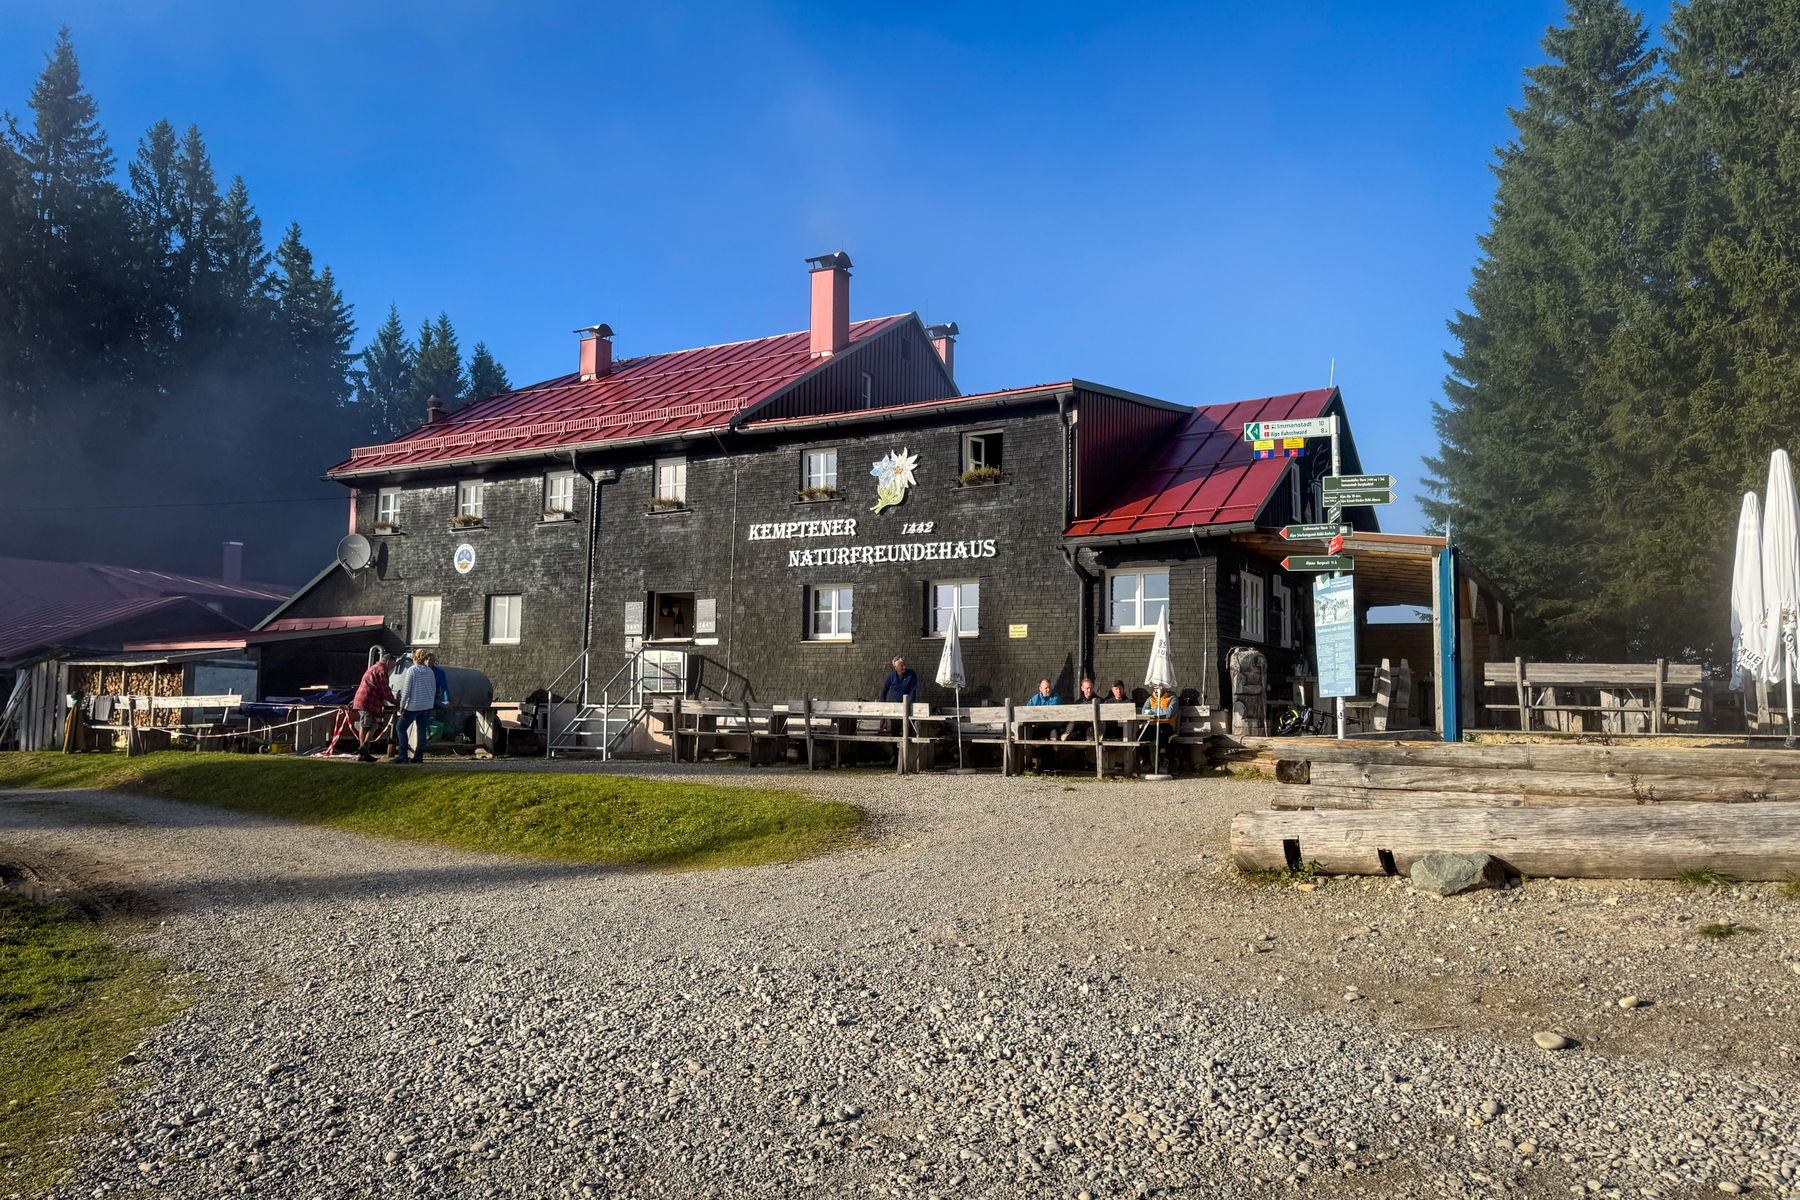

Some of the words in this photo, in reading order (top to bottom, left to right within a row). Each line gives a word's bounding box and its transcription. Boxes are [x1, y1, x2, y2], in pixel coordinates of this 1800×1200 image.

[1276, 421, 1312, 429] Immenstadt
[748, 518, 857, 541] KEMPTENER
[901, 521, 934, 535] 1442
[787, 539, 996, 567] NATURFREUNDEHAUS
